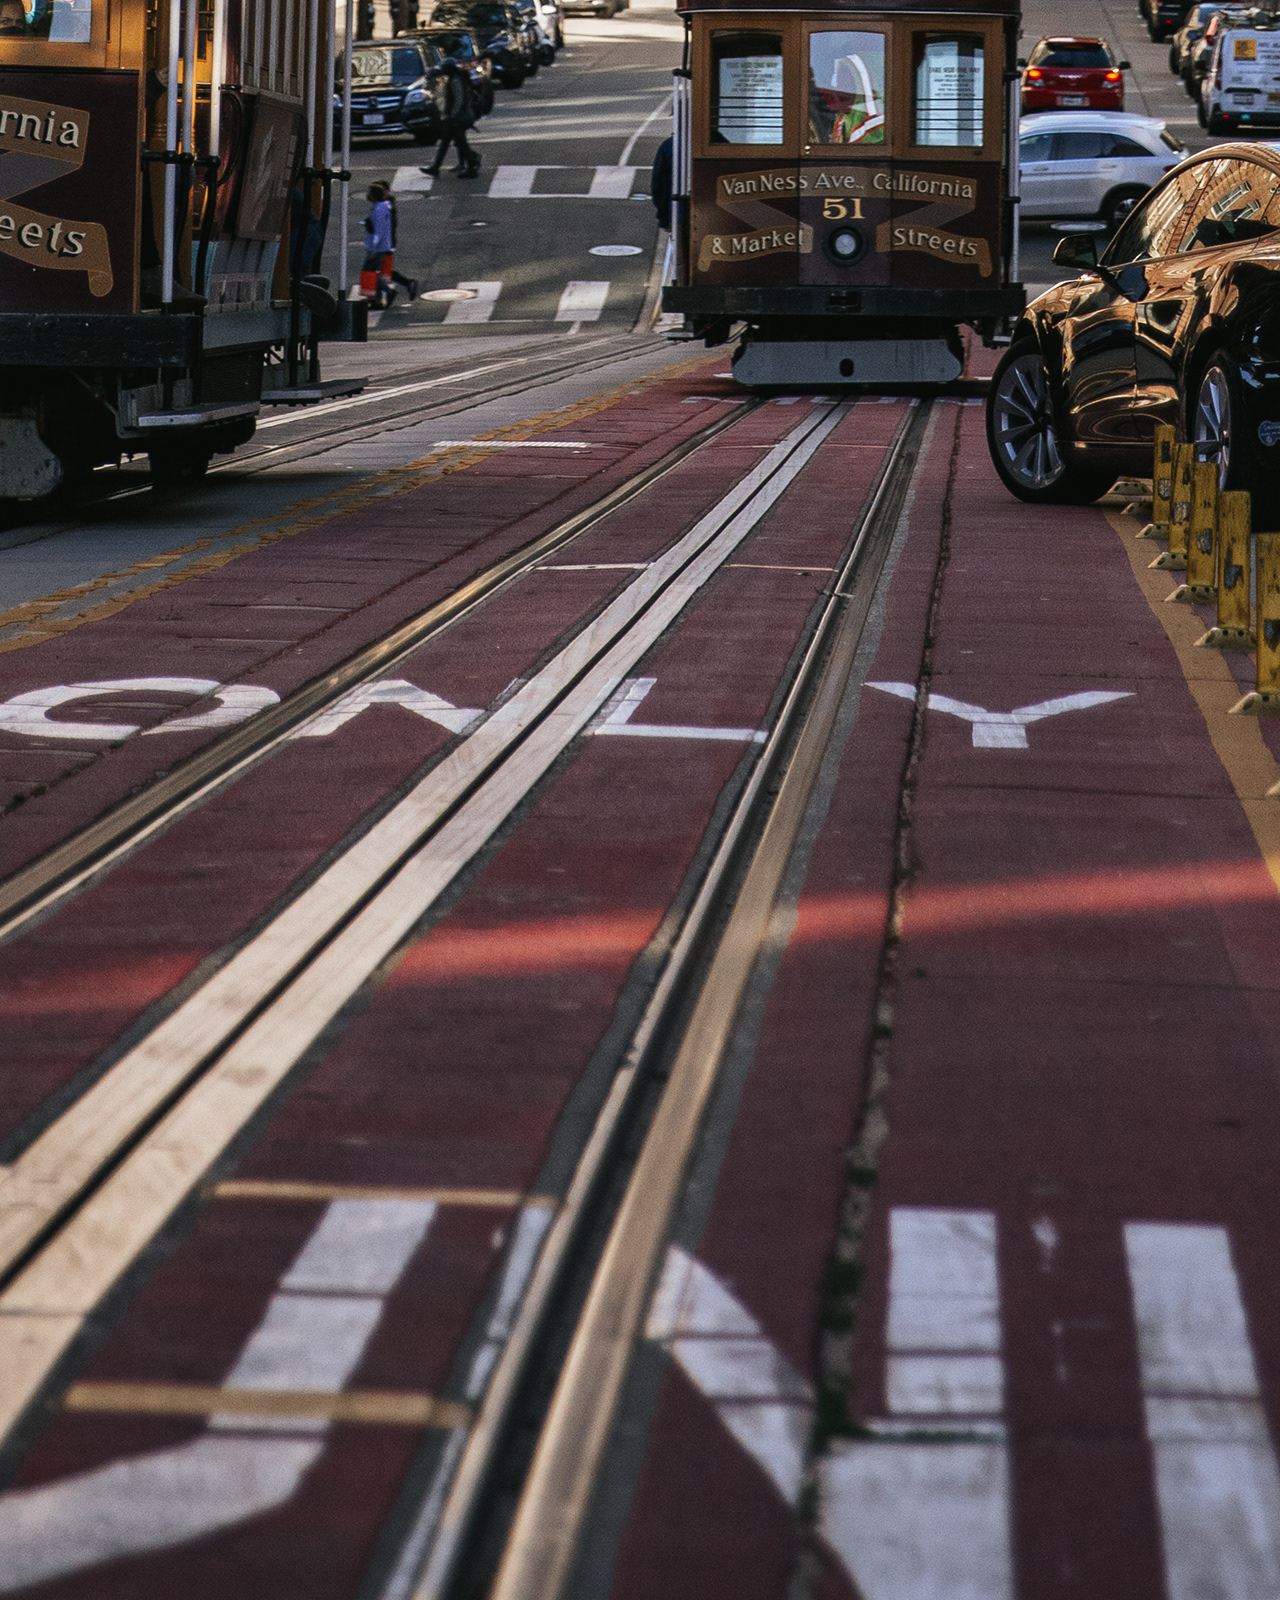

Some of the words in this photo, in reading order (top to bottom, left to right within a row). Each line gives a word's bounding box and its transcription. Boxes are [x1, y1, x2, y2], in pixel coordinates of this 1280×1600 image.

[722, 177, 757, 196] Van
[758, 173, 808, 192] Ness
[872, 172, 974, 199] California
[822, 197, 867, 220] 51
[711, 237, 726, 255] &
[730, 229, 804, 254] Market
[893, 227, 979, 256] Streets
